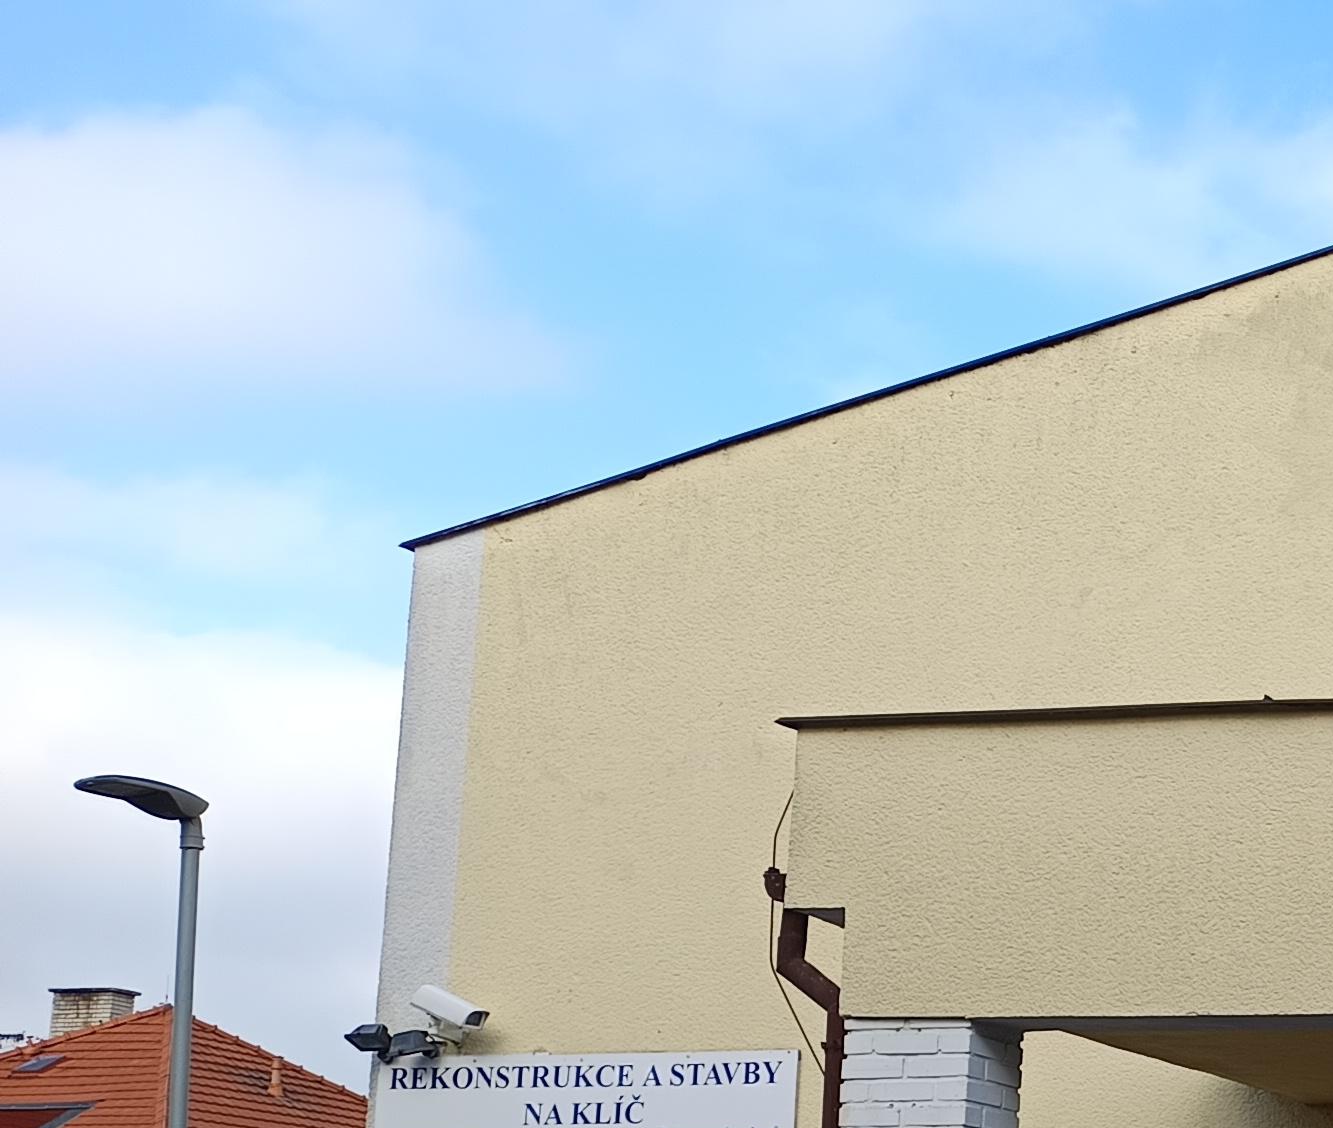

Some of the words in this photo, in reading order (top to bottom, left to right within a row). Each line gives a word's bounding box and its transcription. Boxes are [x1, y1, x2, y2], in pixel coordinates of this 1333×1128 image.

[390, 1064, 634, 1091] REKONSTRUKCE
[642, 1066, 662, 1088] A
[669, 1060, 784, 1088] STAVBY
[522, 1103, 565, 1126] NA
[570, 1095, 645, 1126] KLÍČ
